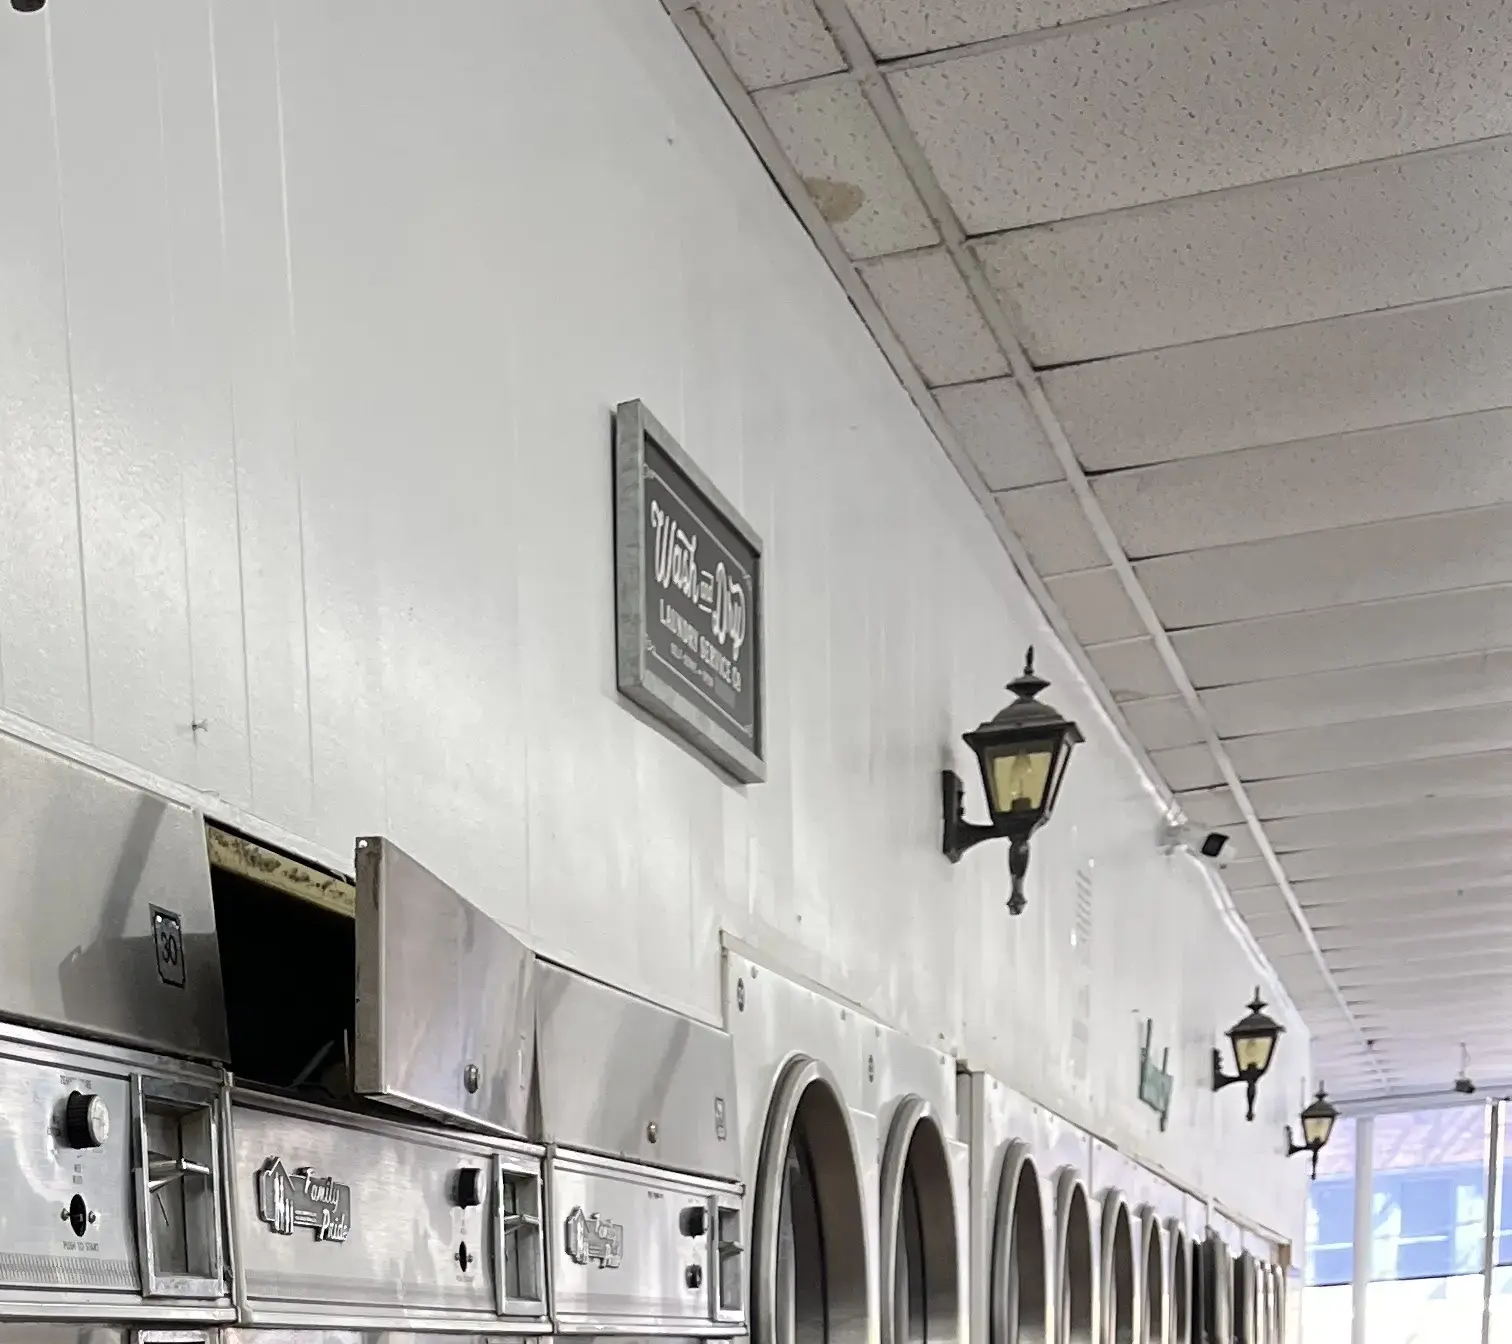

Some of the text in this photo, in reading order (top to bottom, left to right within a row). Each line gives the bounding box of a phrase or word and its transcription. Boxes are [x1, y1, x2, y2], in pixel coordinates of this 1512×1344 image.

[651, 500, 699, 603] Wash
[712, 562, 746, 661] Dry
[161, 932, 178, 965] 30
[296, 1167, 340, 1213] Family
[320, 1209, 348, 1241] Pride
